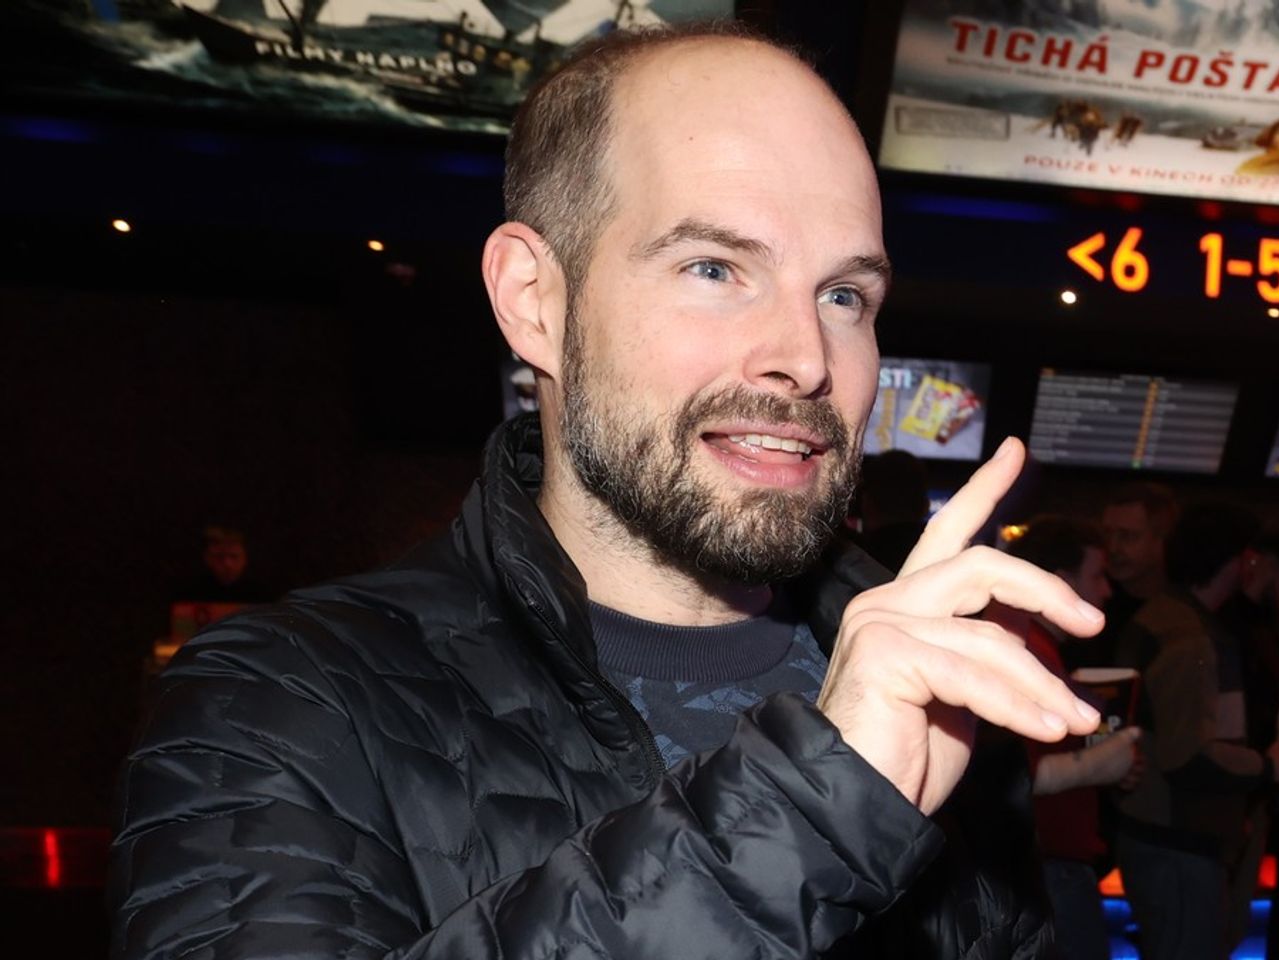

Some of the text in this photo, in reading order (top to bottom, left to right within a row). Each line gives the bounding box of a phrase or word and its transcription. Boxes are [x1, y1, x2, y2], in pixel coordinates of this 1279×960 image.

[254, 41, 478, 75] FILMY NAPLNO
[951, 20, 1109, 75] TICHÁ
[1023, 154, 1099, 173] POUZE
[1107, 163, 1123, 175] V
[1129, 166, 1214, 183] KINECH
